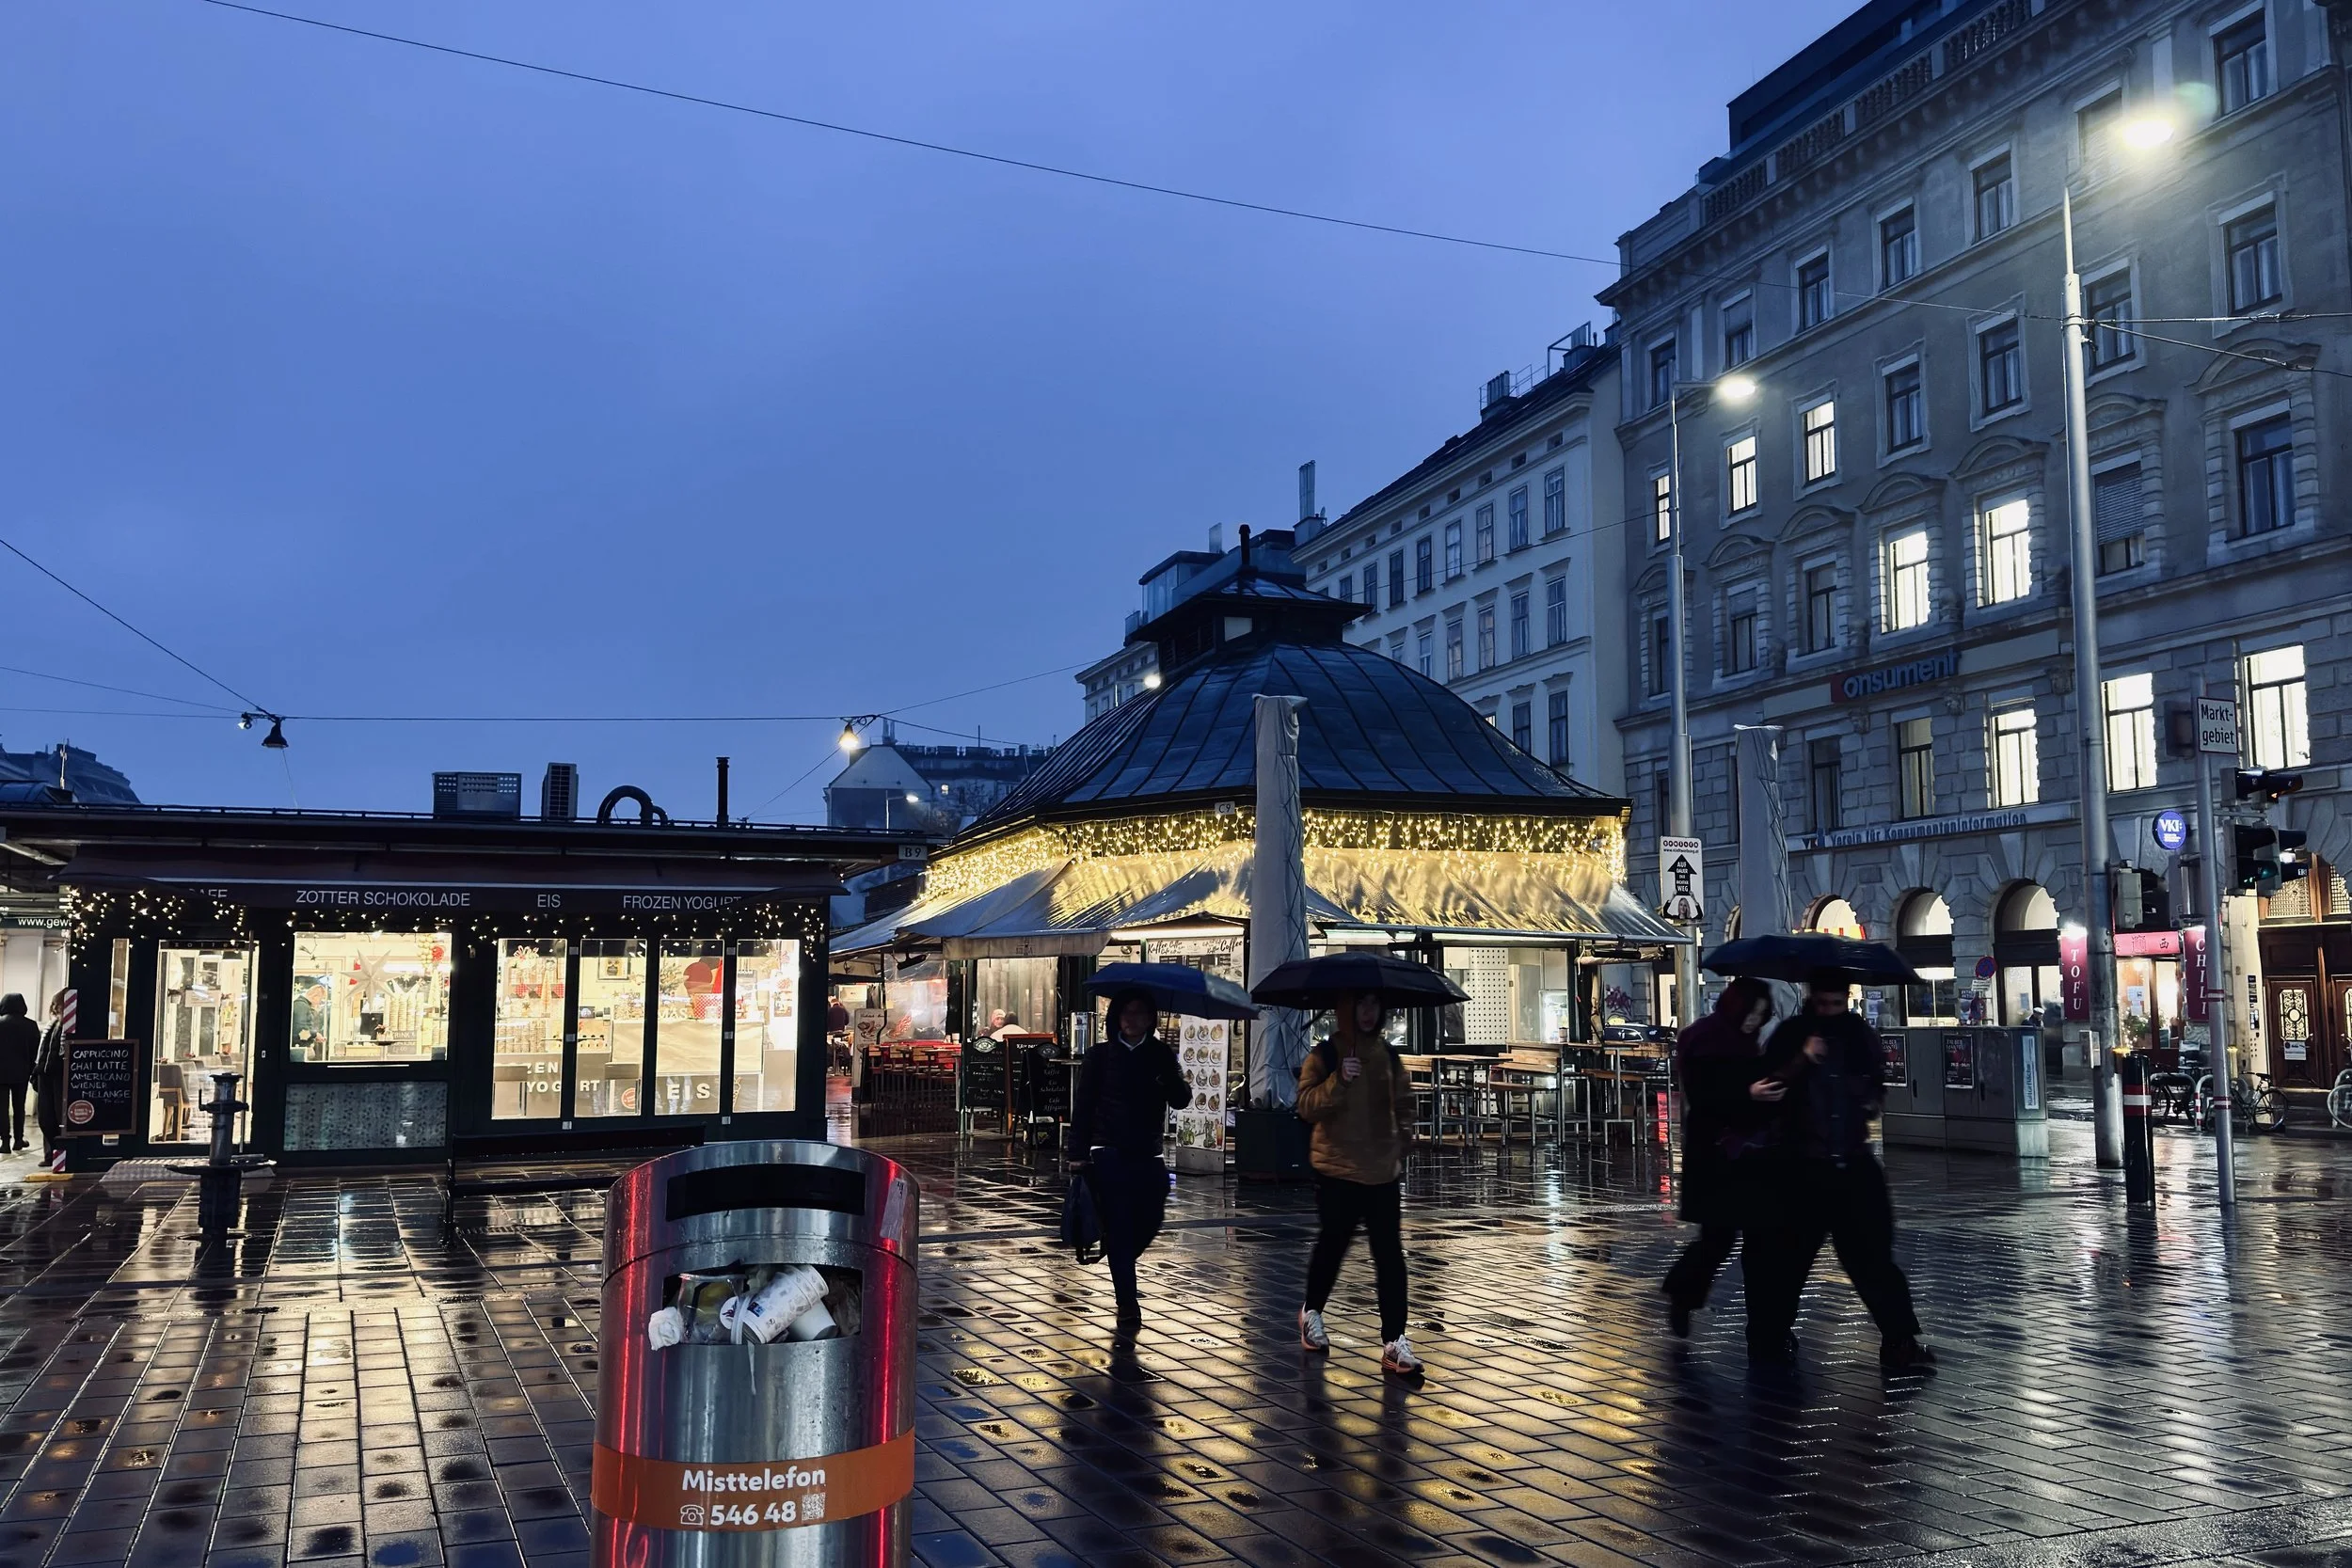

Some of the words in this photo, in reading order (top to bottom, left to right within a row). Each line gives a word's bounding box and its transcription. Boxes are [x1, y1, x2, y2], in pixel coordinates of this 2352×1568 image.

[2201, 704, 2233, 721] Markt-
[2202, 727, 2234, 745] gebiet
[1831, 832, 1862, 847] Verein
[1866, 830, 1880, 844] für
[1884, 812, 2026, 840] Konsumenteninformation
[295, 890, 358, 905] ZOTTER
[363, 891, 470, 907] SCHOKOLADE
[536, 894, 561, 908] EIS
[623, 895, 681, 910] FROZEN
[18, 917, 72, 929] www.gew
[1220, 936, 1243, 953] Coffee
[2070, 948, 2082, 1010] TOFU
[2195, 938, 2208, 1015] CHILI
[72, 1049, 129, 1059] CAPPUCCINO
[71, 1061, 92, 1071] CHAI
[97, 1061, 128, 1070] LATTE
[71, 1072, 131, 1082] AMERICANO
[81, 1089, 132, 1099] MELANGE
[667, 1083, 710, 1101] EIS
[681, 1465, 827, 1493] Misttelefon
[710, 1503, 759, 1527] 546
[763, 1500, 797, 1524] 48
